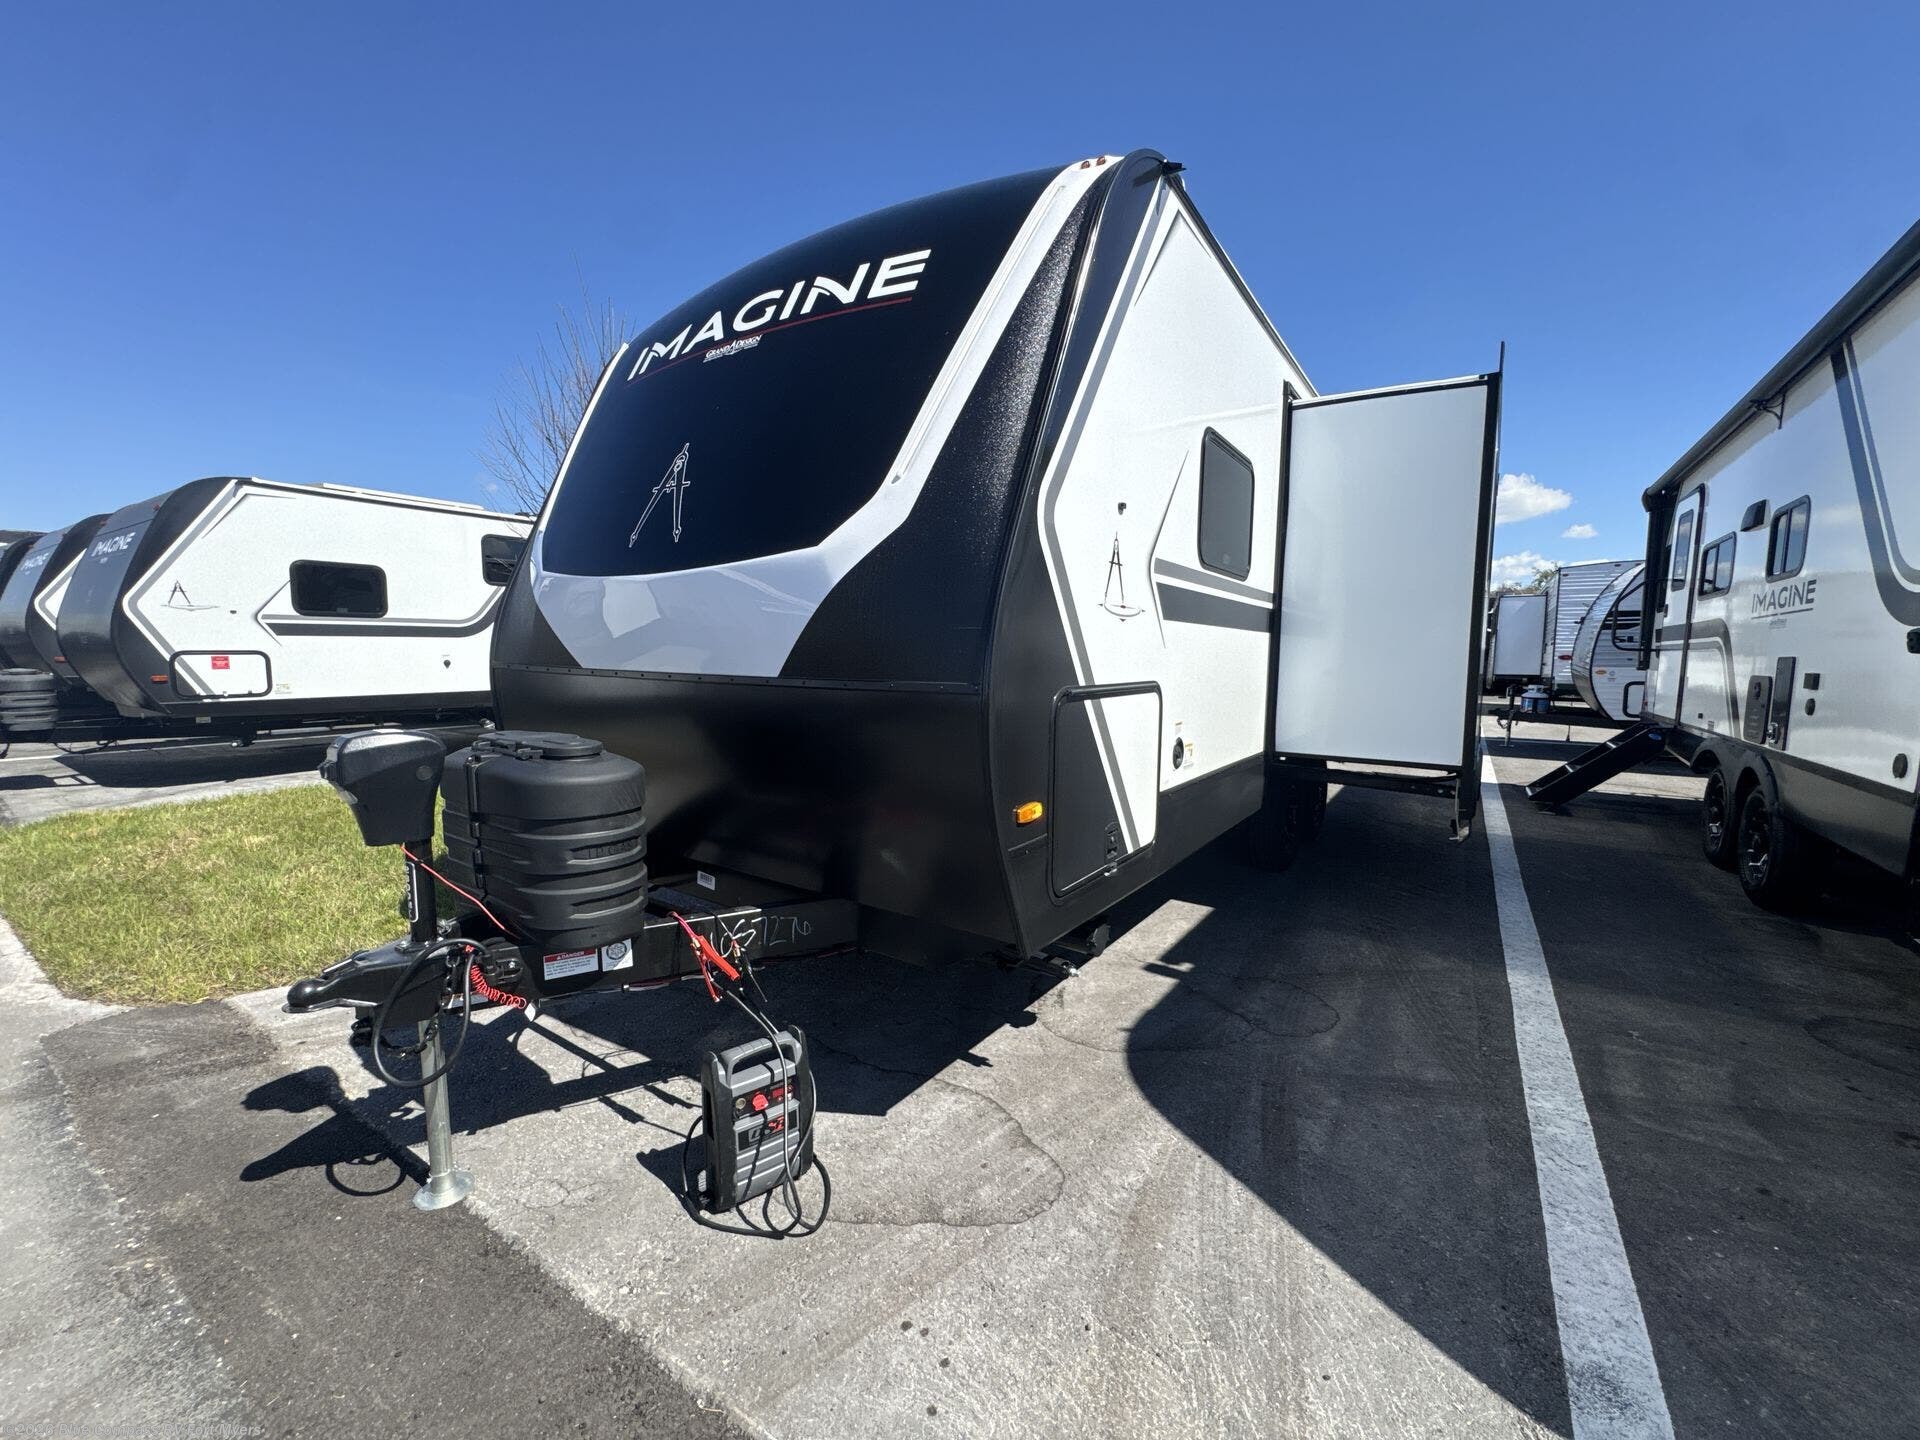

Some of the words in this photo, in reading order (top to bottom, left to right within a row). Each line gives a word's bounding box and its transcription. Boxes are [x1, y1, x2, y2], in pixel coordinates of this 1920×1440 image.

[627, 248, 931, 381] IMAGINE
[91, 532, 137, 557] IMAGINE
[1751, 579, 1817, 613] IMAGINE
[561, 951, 585, 960] DANGER
